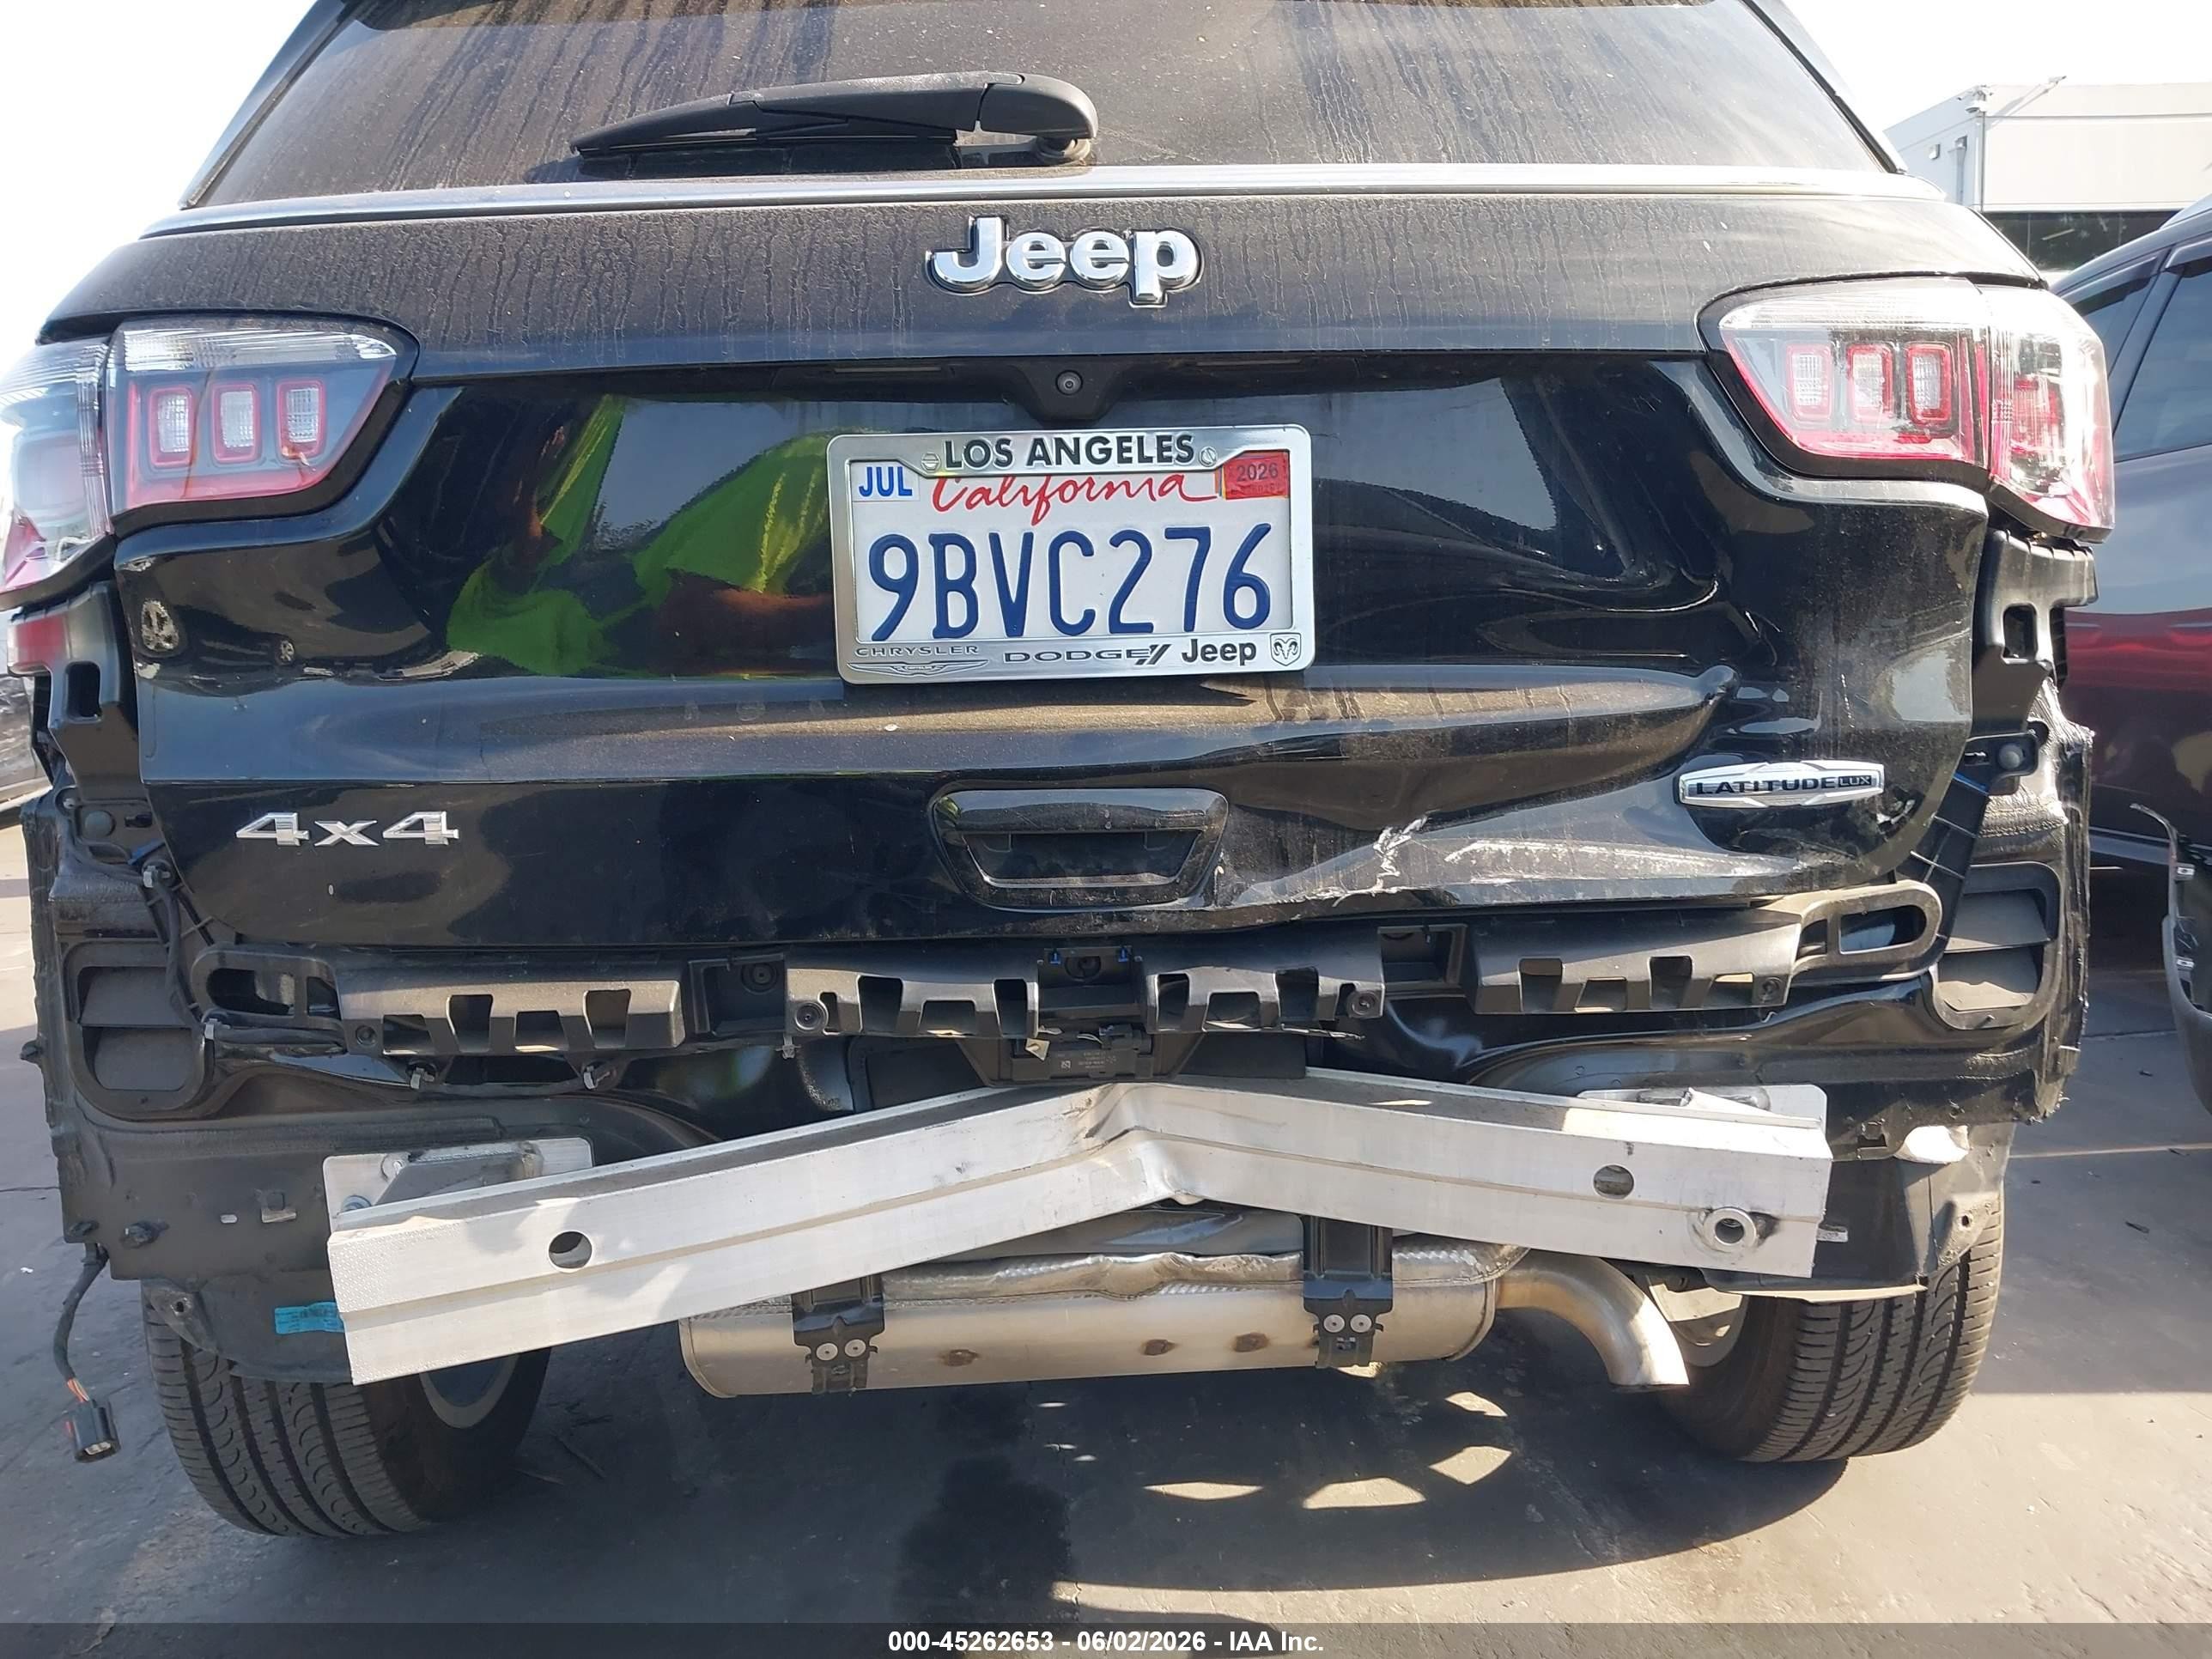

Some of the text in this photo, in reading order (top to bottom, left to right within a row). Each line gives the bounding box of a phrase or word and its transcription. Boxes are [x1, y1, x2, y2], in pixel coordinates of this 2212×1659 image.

[927, 216, 1202, 306] Jeep
[945, 434, 1194, 469] LOS ANGELES
[859, 466, 913, 497] JUL
[1237, 462, 1278, 482] 2026
[931, 473, 1218, 526] California
[868, 522, 1273, 642] 9BVC276
[854, 645, 979, 658] CHRYSLER
[1003, 648, 1149, 663] DODGE
[1181, 638, 1257, 666] Jeep
[1696, 775, 1872, 795] LATITUDE LUX
[236, 811, 459, 846] 4x4
